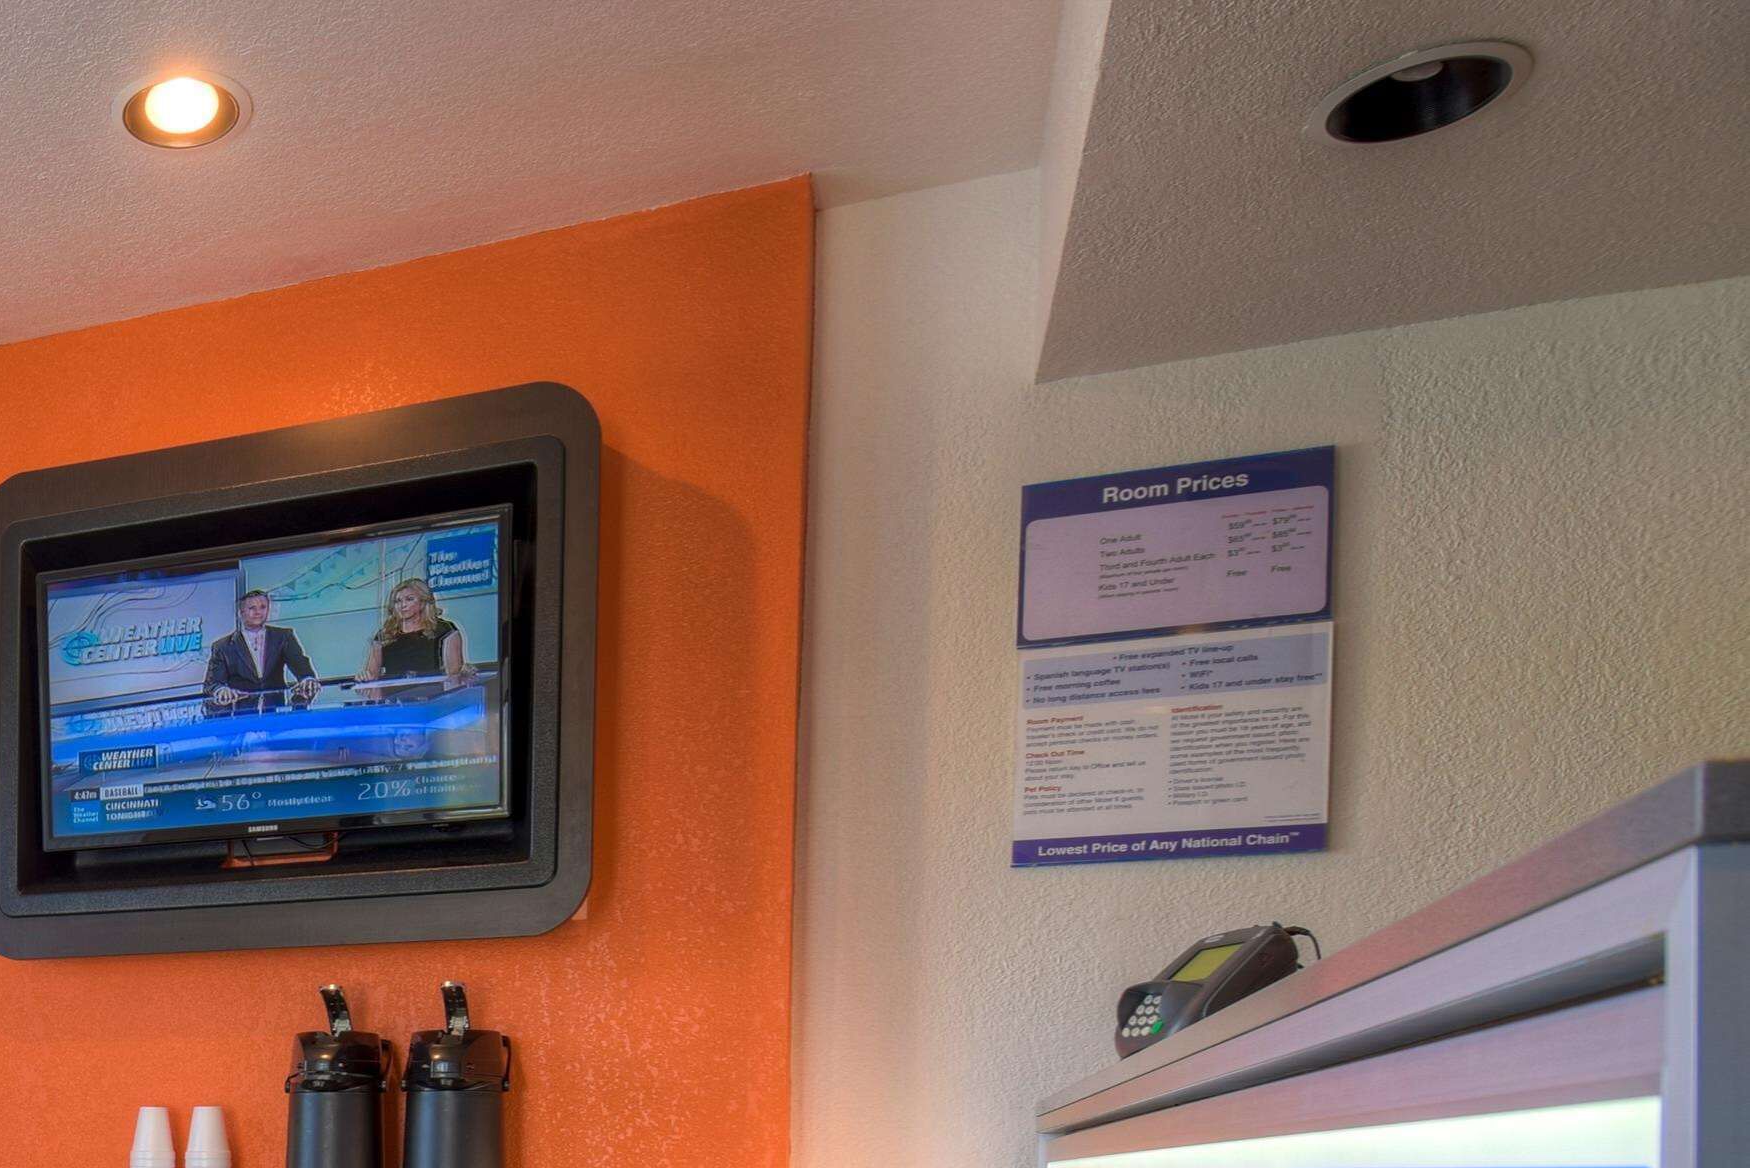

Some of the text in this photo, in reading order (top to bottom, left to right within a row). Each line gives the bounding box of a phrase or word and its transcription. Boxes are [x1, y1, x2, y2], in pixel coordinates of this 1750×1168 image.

[1102, 472, 1250, 503] Room Prices
[98, 616, 203, 645] WEATHER
[81, 639, 158, 665] CENTER
[92, 759, 131, 771] CENTER
[101, 747, 154, 762] WEATHER
[104, 786, 139, 799] BASEBALL
[357, 778, 411, 801] 20%
[105, 799, 159, 811] CINCINNATI
[1037, 845, 1088, 857] Lowest
[1091, 842, 1128, 855] Price
[1131, 839, 1146, 852] of
[1149, 839, 1177, 853] Any
[1181, 834, 1242, 850] National
